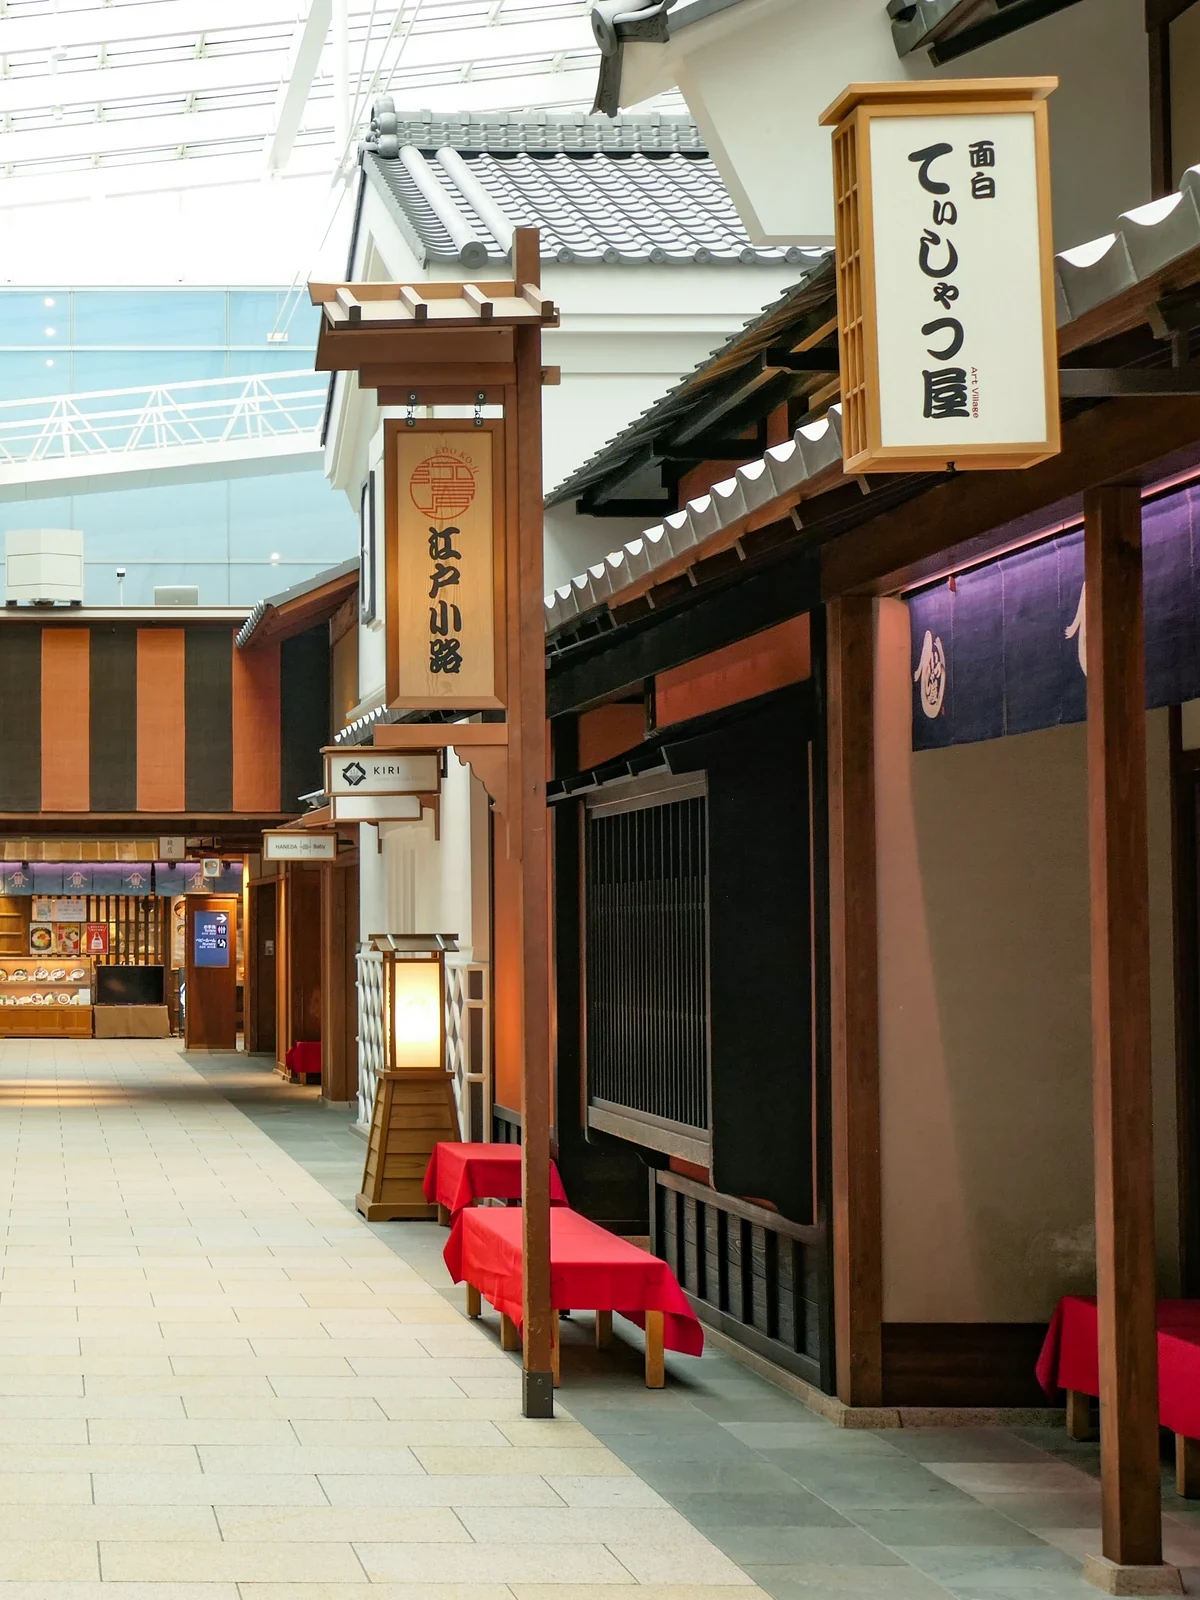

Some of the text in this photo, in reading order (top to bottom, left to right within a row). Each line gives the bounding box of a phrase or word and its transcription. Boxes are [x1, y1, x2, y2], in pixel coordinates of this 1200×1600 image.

[968, 140, 996, 200] 面白
[907, 142, 971, 419] てぃしゃつ屋
[970, 366, 980, 419] Art Village
[435, 446, 480, 474] EDO KO-JI
[428, 526, 464, 674] 江戸小路
[373, 766, 400, 775] KIRI
[313, 843, 326, 851] Baby
